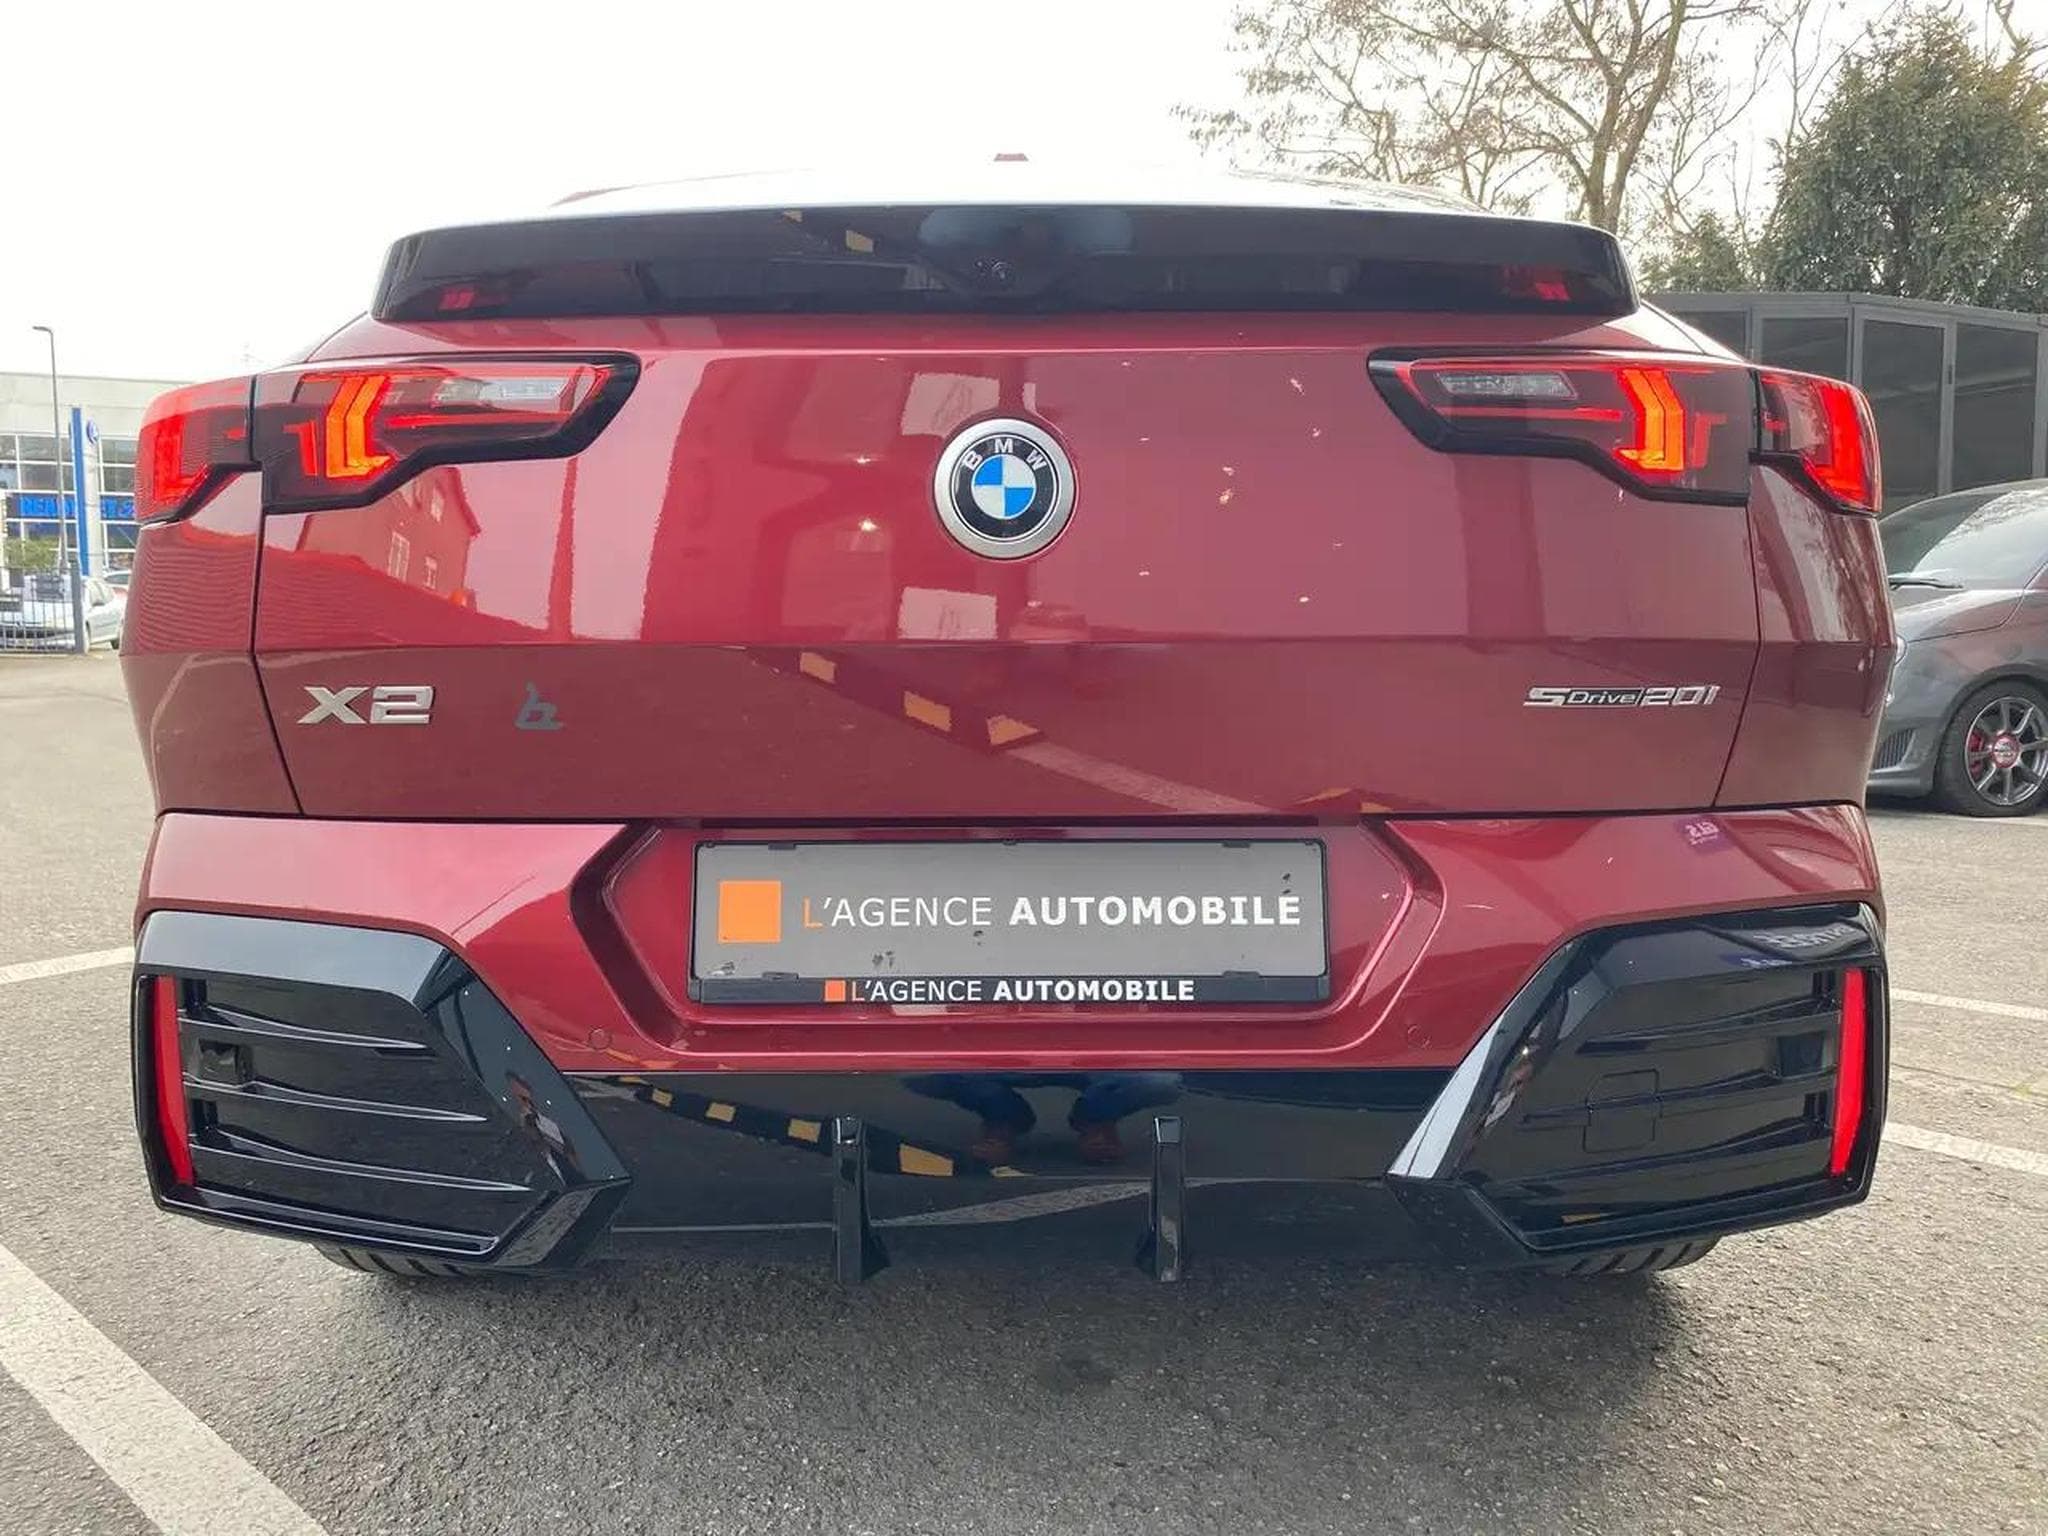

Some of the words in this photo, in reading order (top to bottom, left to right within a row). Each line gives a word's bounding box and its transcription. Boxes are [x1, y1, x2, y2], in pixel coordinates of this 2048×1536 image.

[961, 437, 1047, 471] BMW
[297, 685, 434, 724] X2
[1008, 895, 1301, 926] AUTOMOBILE
[992, 979, 1196, 1002] AUTOMOBILE
